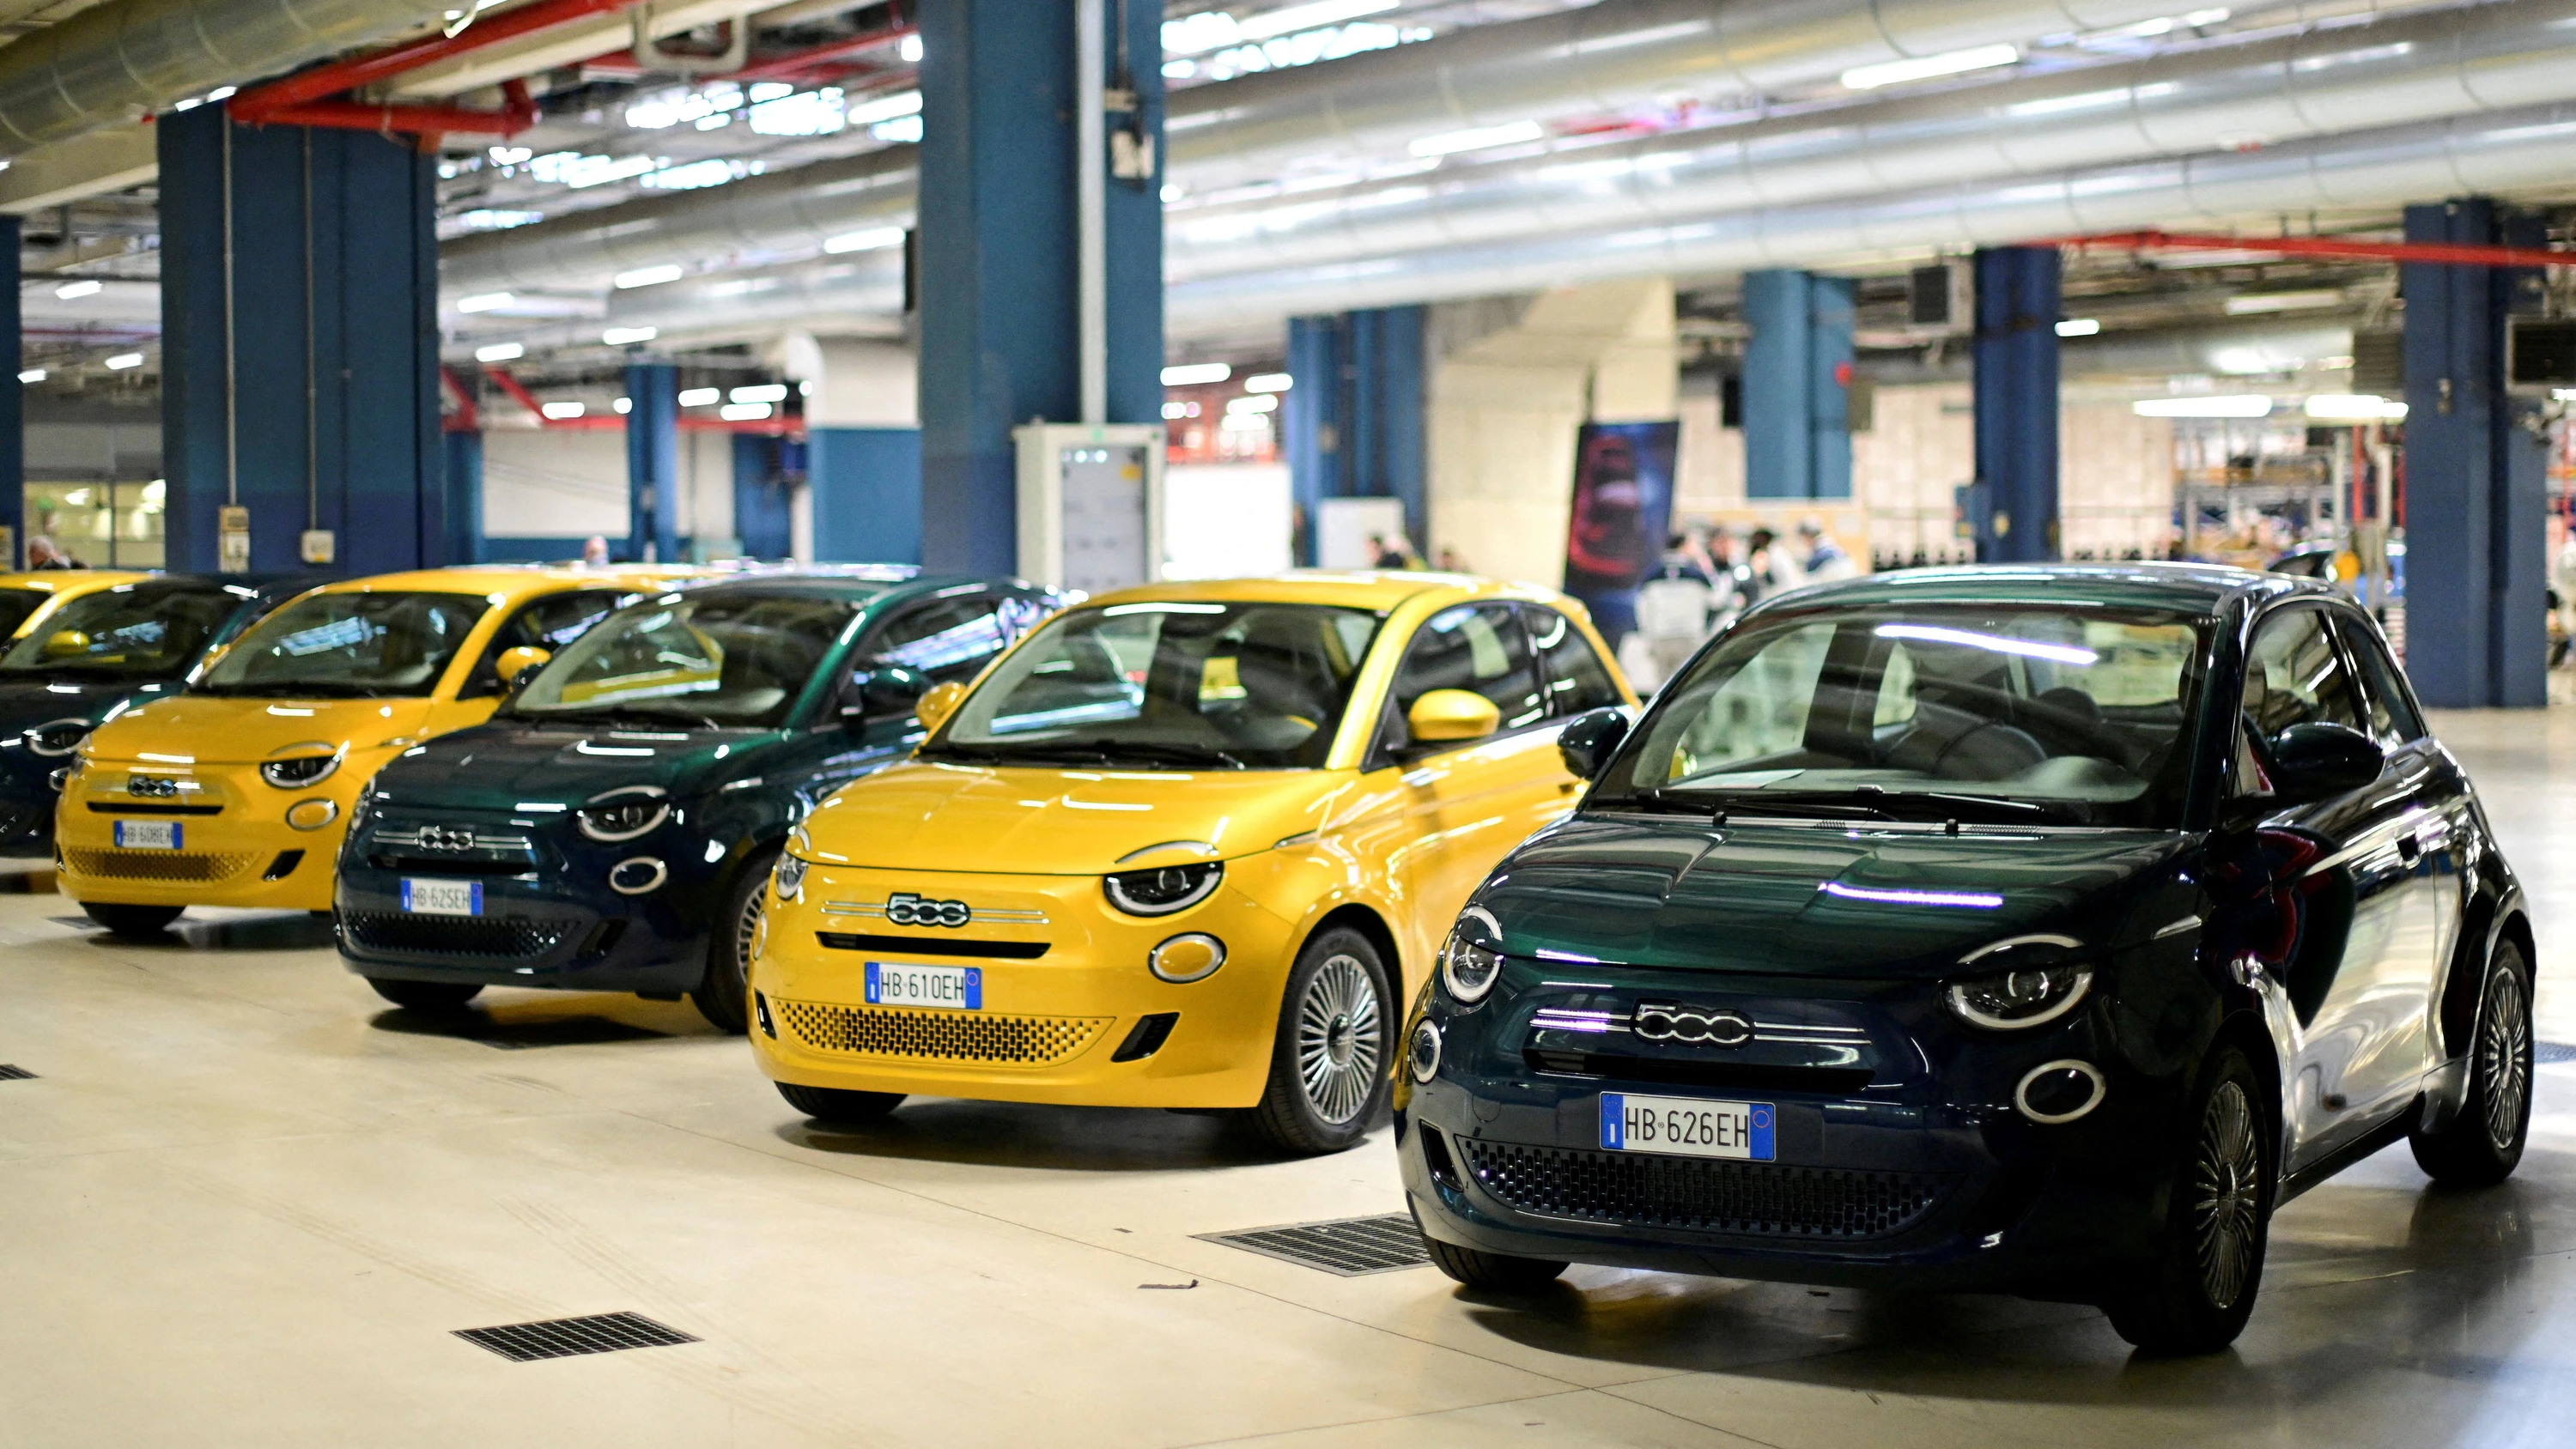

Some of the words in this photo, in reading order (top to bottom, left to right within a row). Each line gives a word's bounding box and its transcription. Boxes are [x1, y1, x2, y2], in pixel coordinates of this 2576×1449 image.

[412, 887, 427, 906] HB
[431, 887, 469, 909] 625EH
[888, 895, 968, 925] 500
[881, 973, 902, 997] HB
[909, 974, 964, 1000] 610EH
[1635, 1003, 1750, 1044] 500
[1625, 1107, 1656, 1141] HB
[1668, 1110, 1748, 1148] 626EH
